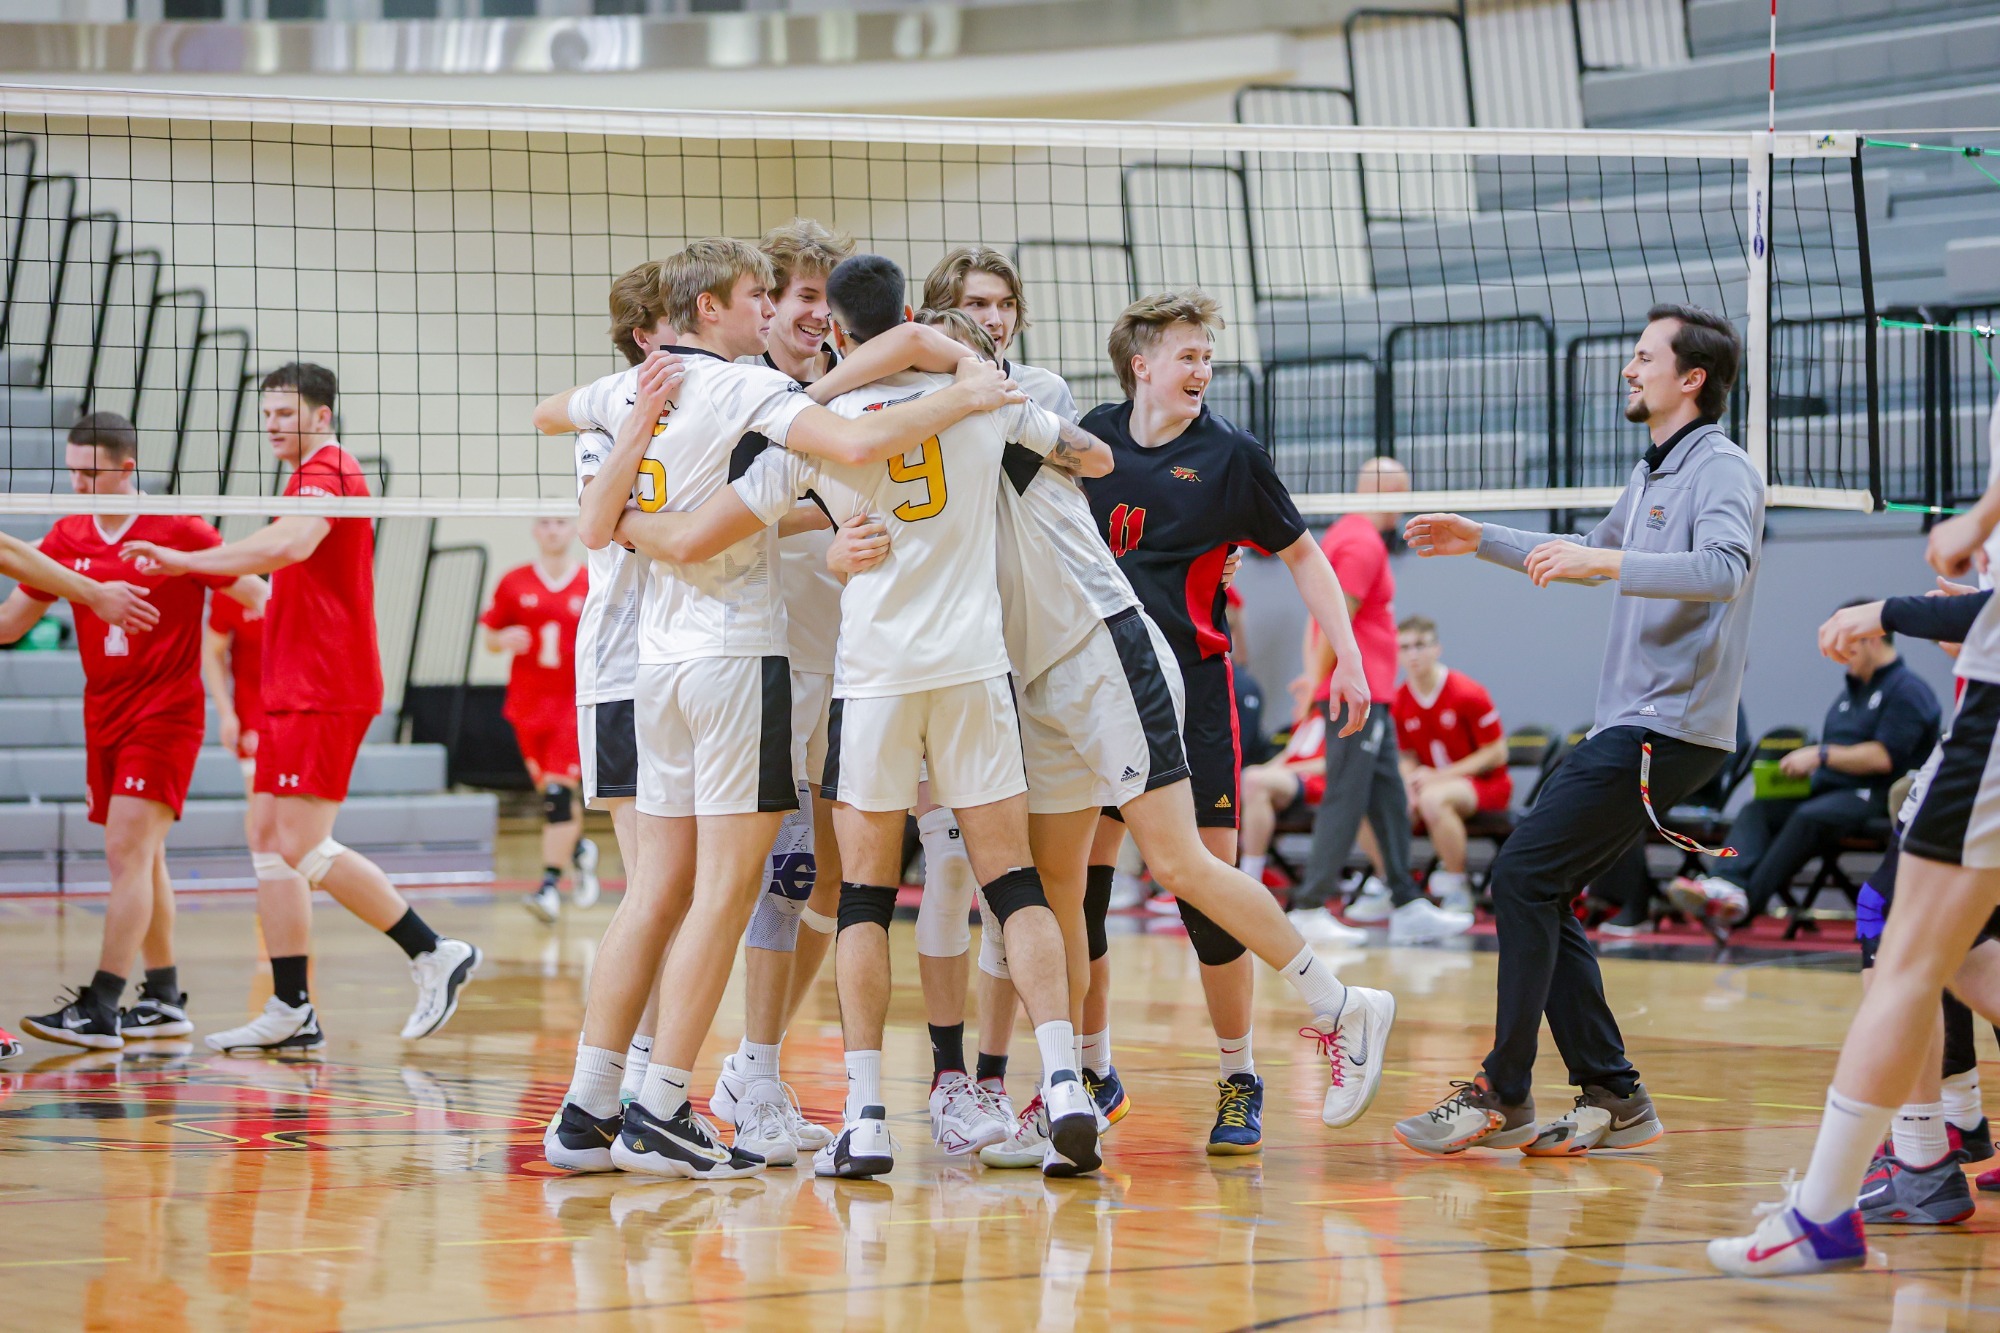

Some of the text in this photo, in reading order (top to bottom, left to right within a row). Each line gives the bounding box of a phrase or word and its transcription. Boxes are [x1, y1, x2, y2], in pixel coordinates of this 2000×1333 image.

[636, 423, 668, 513] 5
[887, 434, 948, 523] 9
[1109, 503, 1147, 559] 11
[1120, 771, 1140, 782] adidas
